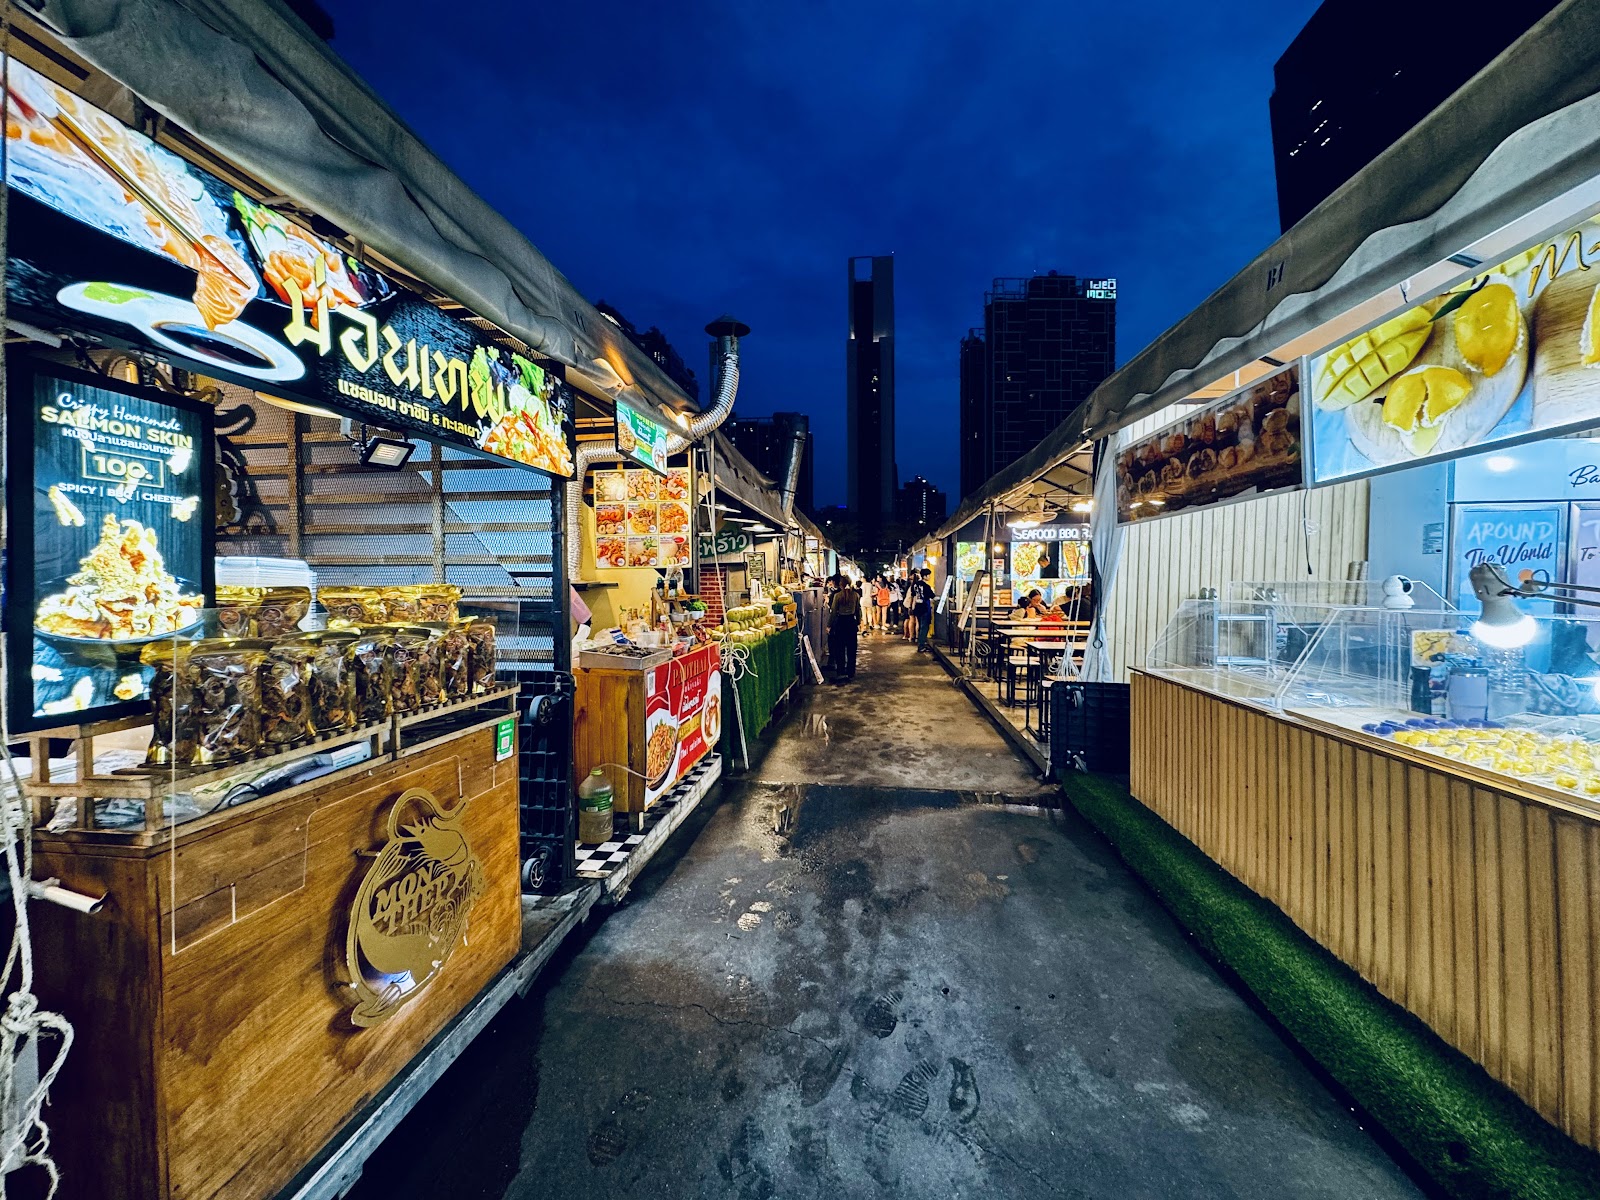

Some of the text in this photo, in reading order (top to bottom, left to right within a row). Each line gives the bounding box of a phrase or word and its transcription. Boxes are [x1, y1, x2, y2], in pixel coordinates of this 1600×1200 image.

[1527, 231, 1600, 298] M
[338, 379, 396, 411] แซลมอน
[58, 393, 182, 431] Crispy Homemade
[41, 406, 192, 449] SALMON SKIN
[58, 482, 184, 505] SPICY BBQ CHEESE
[699, 532, 748, 556] พร้าว
[1013, 528, 1057, 539] SEAFOOD
[1059, 528, 1079, 539] BBQ
[1467, 521, 1553, 545] AROUND
[1465, 541, 1553, 568] The World
[1581, 546, 1596, 561] To
[373, 861, 435, 921] MON
[383, 871, 456, 936] THEP
